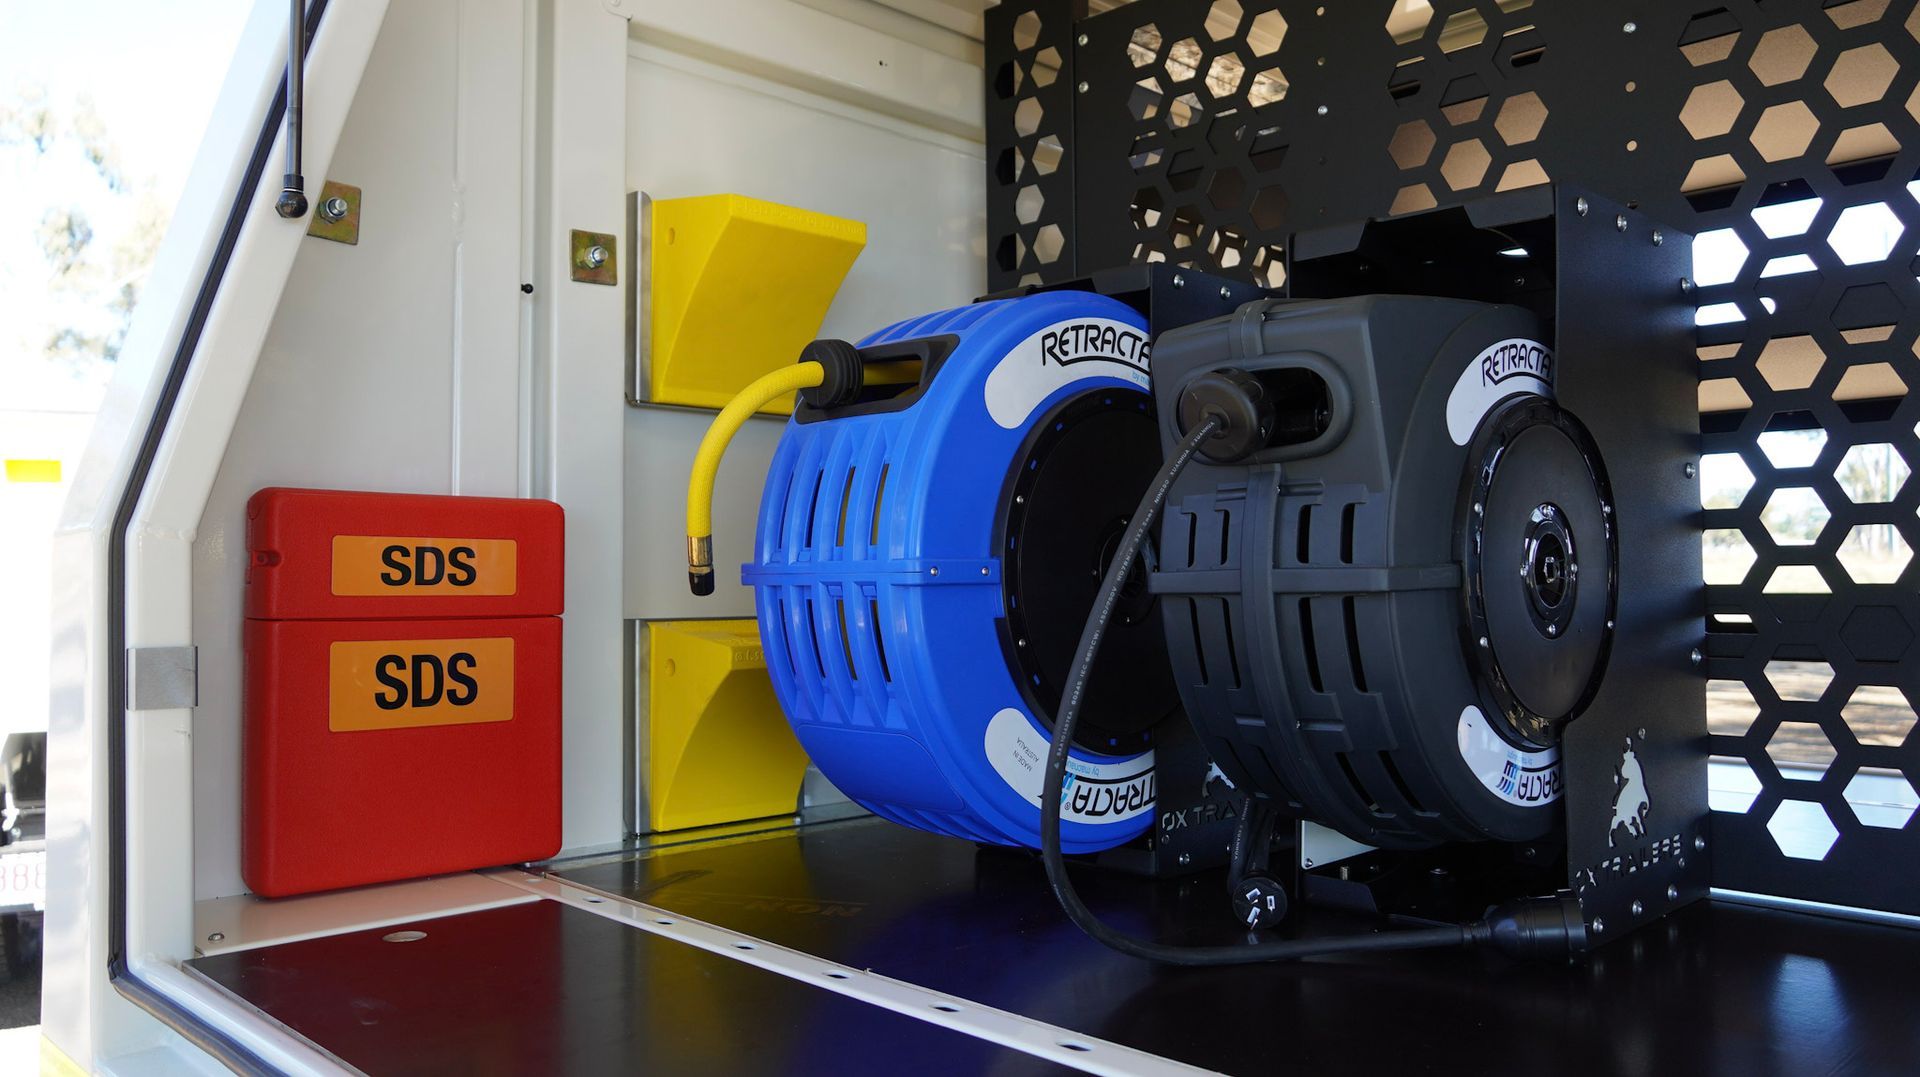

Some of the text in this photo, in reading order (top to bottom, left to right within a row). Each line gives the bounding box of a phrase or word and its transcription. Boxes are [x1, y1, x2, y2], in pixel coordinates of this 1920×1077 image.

[1041, 324, 1151, 370] RETRACTA
[1481, 343, 1553, 387] RETRACTA
[1169, 448, 1191, 477] XUANHUA
[380, 544, 477, 586] SDS
[374, 652, 478, 710] SDS
[1015, 736, 1039, 763] AUSTRALIA
[1017, 755, 1033, 772] MADE
[1162, 811, 1188, 831] OX
[1193, 804, 1241, 825] TRA
